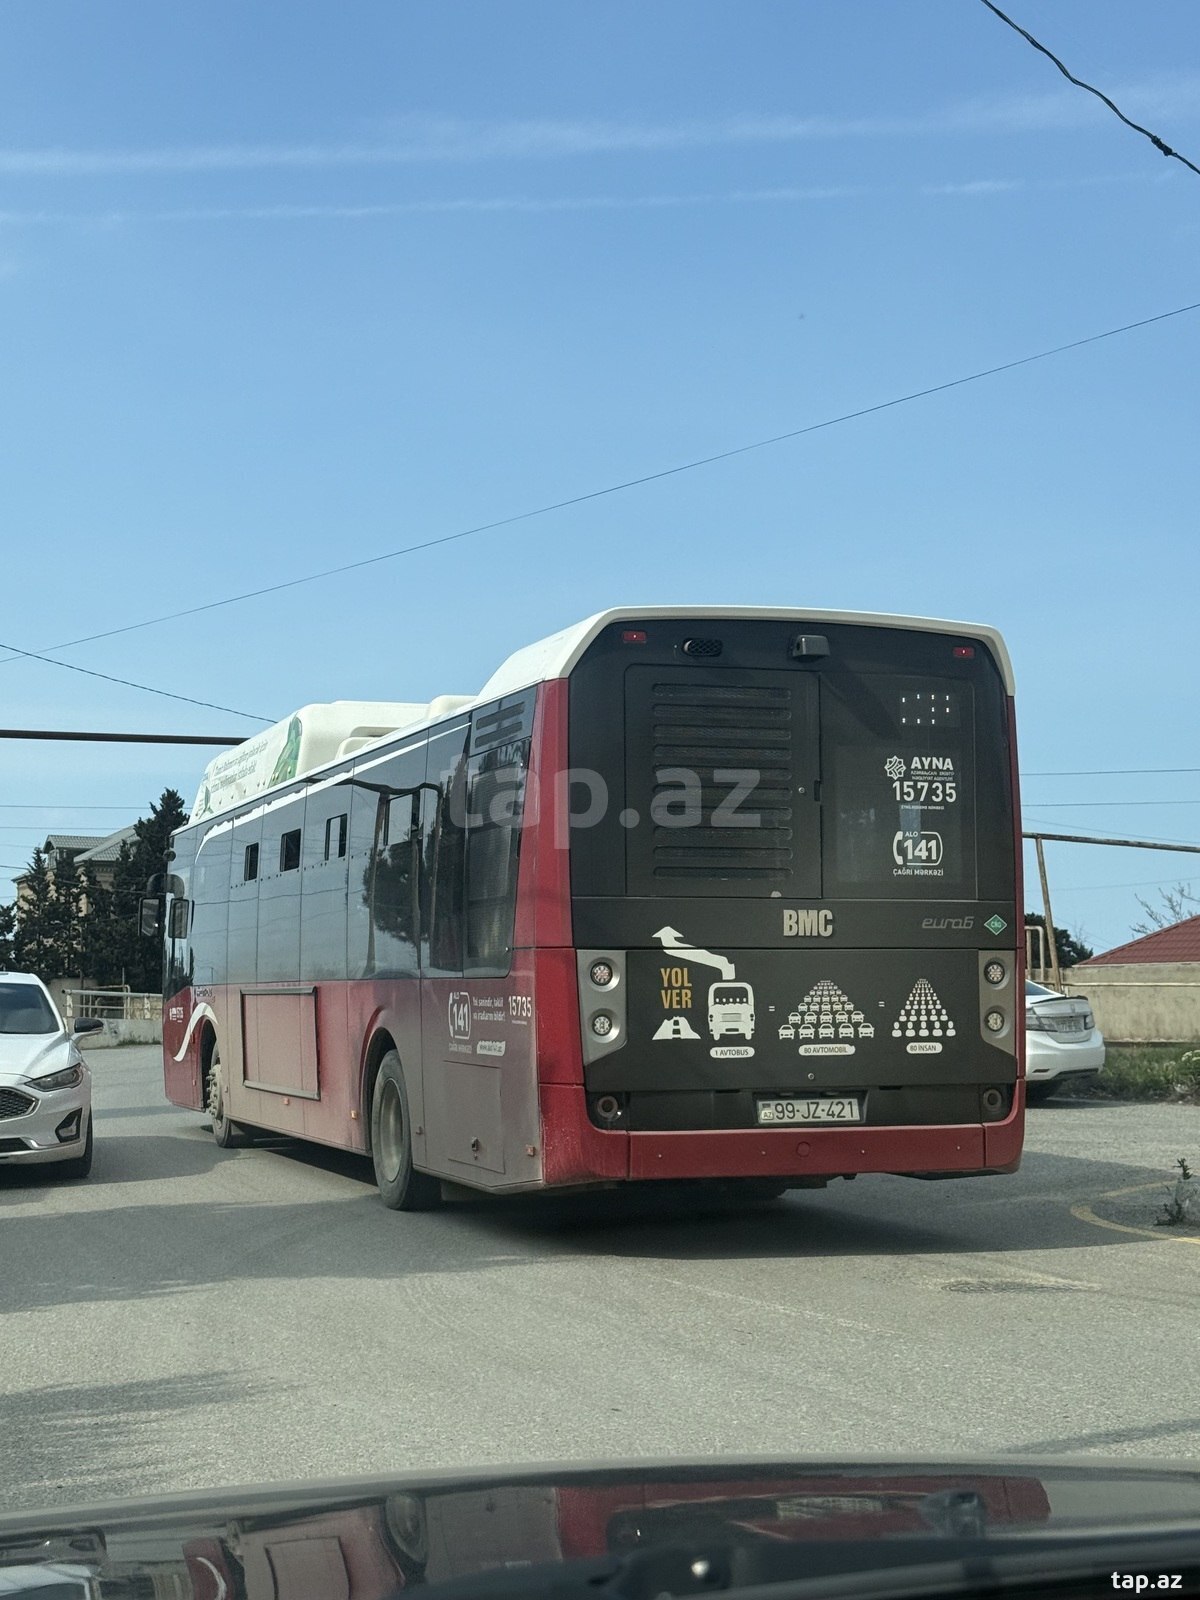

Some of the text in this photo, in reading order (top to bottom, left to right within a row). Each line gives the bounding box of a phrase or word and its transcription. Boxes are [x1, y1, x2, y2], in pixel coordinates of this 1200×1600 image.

[911, 756, 954, 771] AYNA
[892, 781, 957, 803] 15735
[904, 839, 937, 860] 141
[893, 867, 944, 877] ÇAĞRI MƏRKƏZİ
[783, 909, 833, 937] BMC
[661, 967, 692, 988] YOL
[508, 996, 532, 1017] 15735
[661, 989, 692, 1009] VER
[453, 1003, 469, 1031] 141
[720, 1049, 749, 1057] AVTOBUS
[774, 1101, 854, 1119] 99-JZ-421
